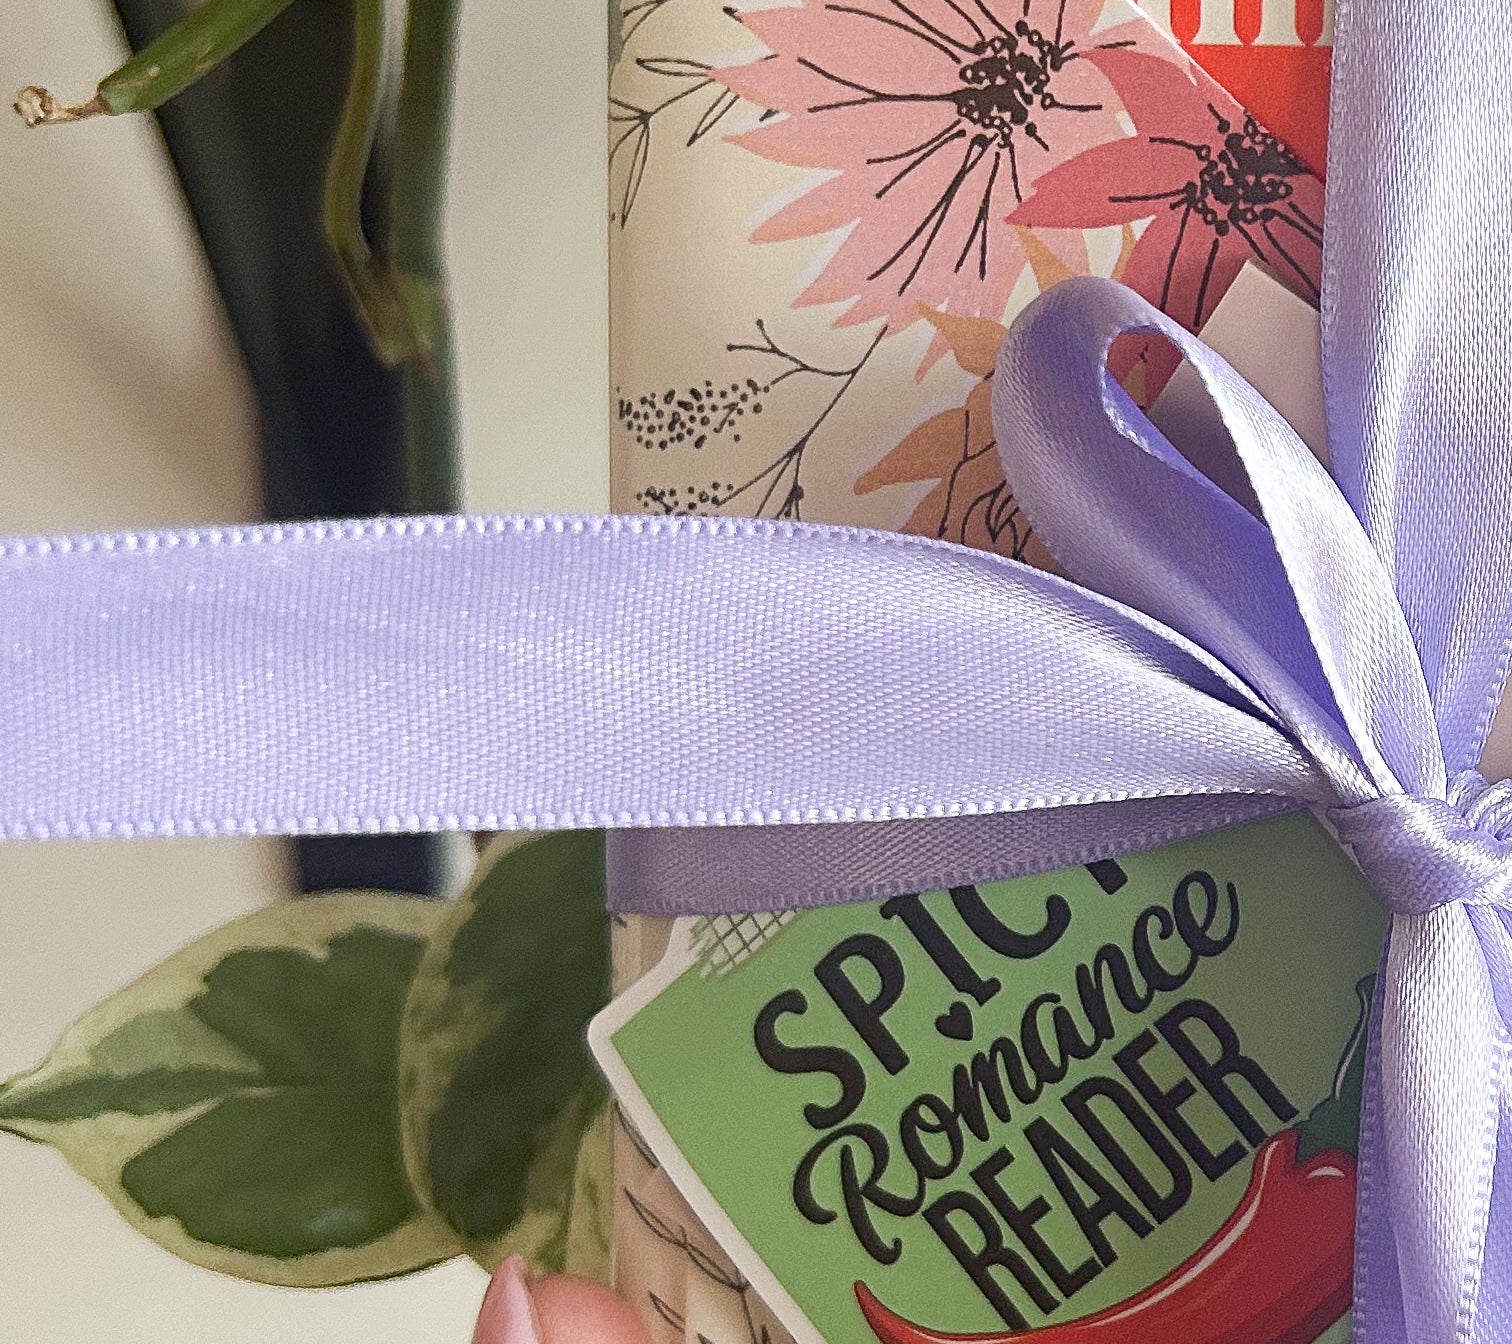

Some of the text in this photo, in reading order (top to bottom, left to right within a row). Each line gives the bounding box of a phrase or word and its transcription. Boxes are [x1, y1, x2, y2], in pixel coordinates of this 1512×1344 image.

[753, 859, 1128, 1129] SPIC
[793, 868, 1240, 1265] Romance
[921, 997, 1299, 1333] READER
